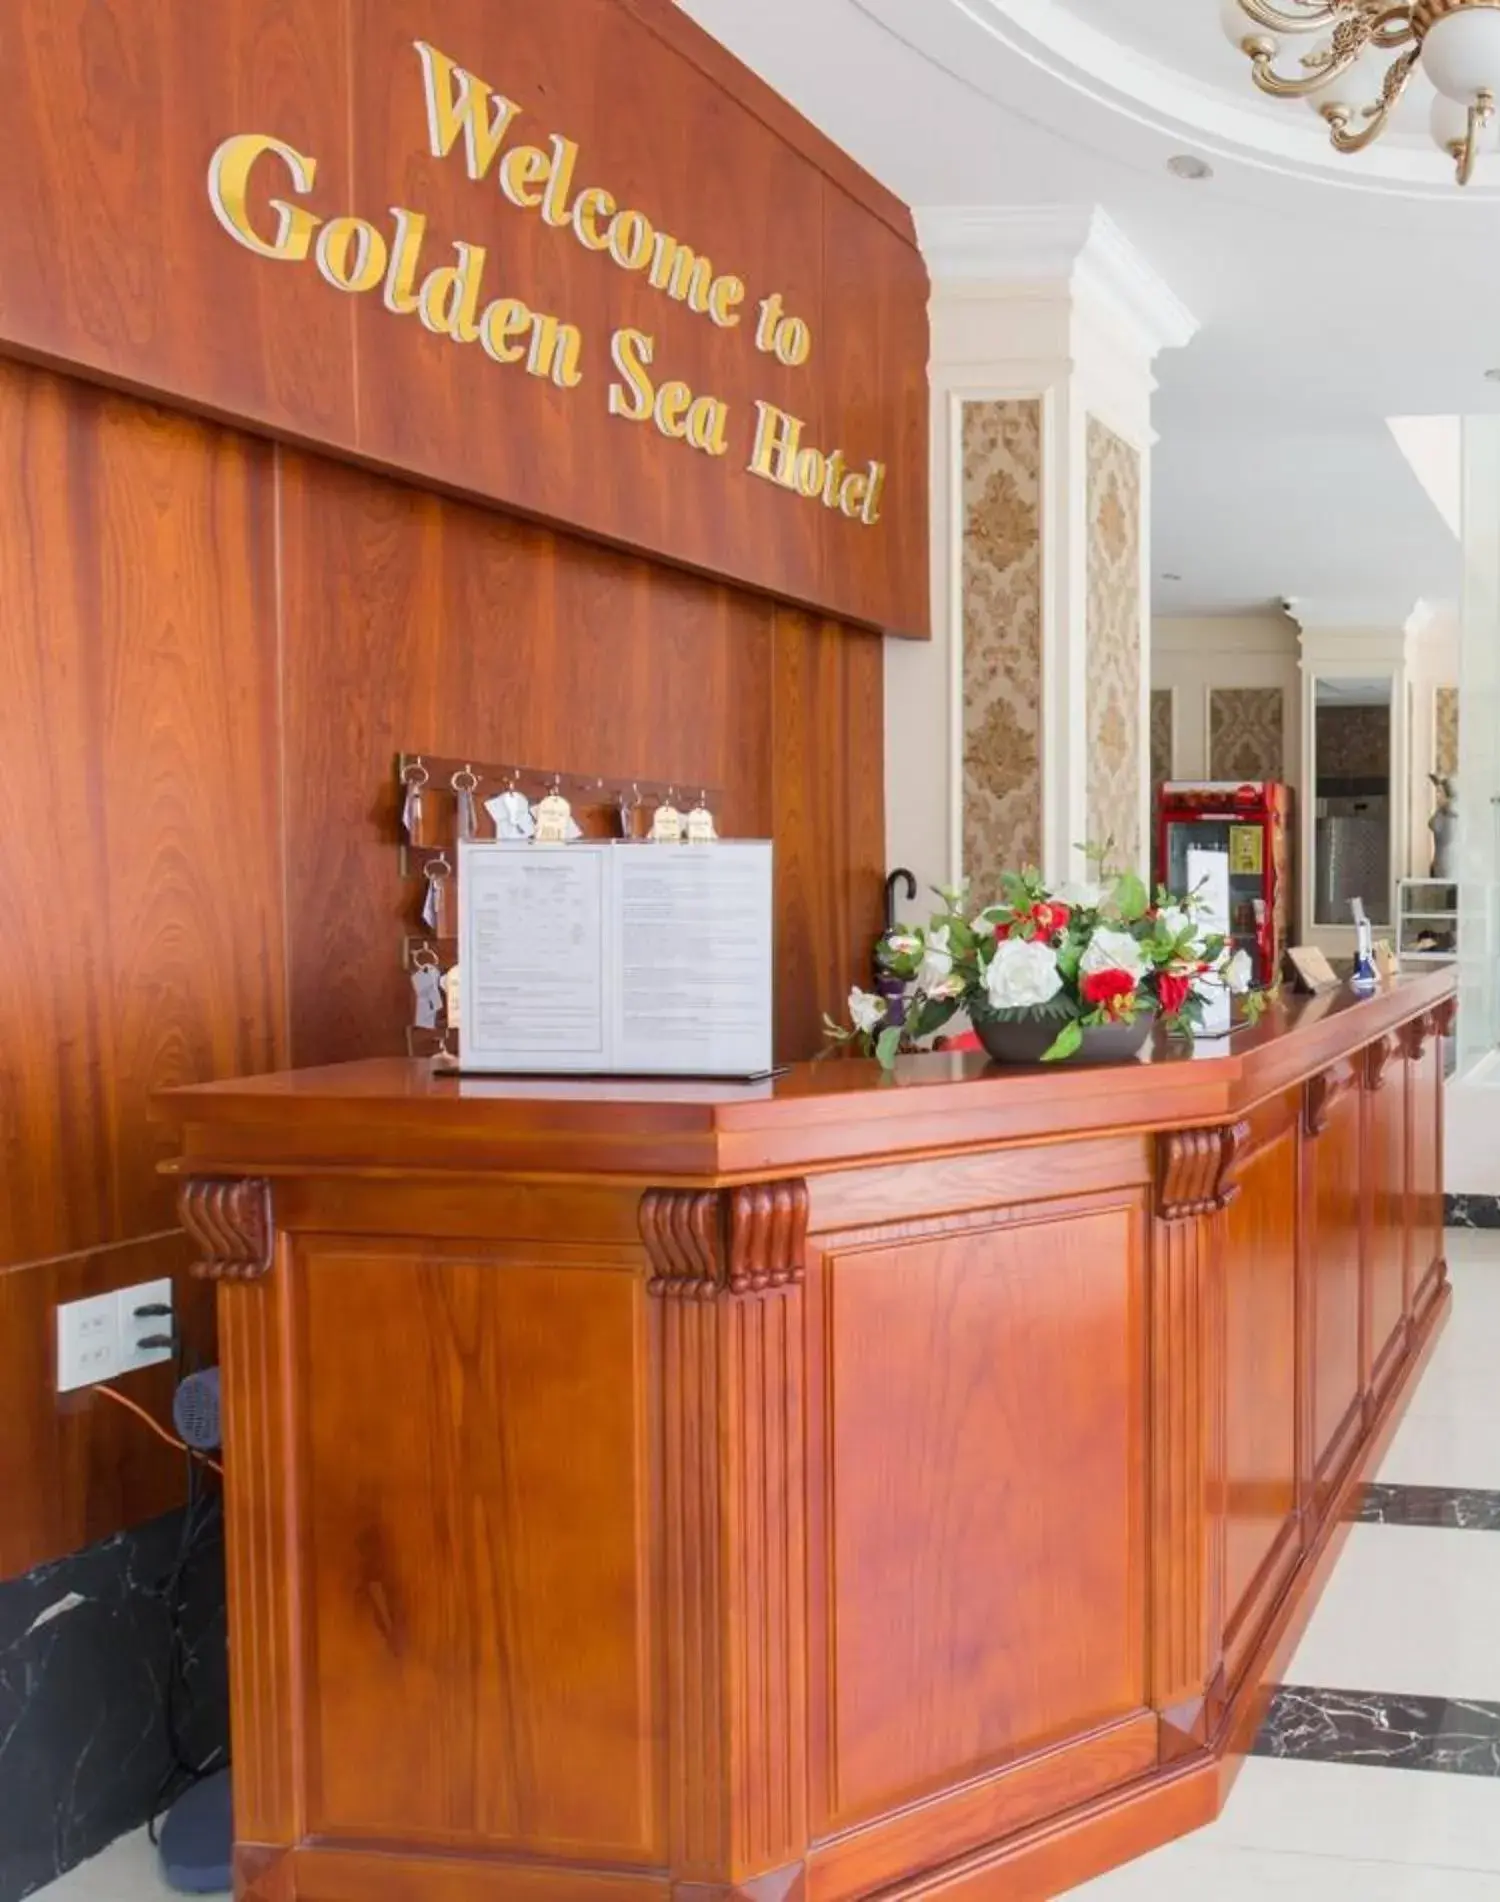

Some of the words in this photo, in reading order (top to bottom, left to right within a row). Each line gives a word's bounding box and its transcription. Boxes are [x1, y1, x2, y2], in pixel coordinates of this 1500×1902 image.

[207, 133, 582, 387] Golden
[609, 328, 727, 455] Sea
[746, 400, 885, 524] Hotel
[414, 41, 744, 327] Welcome
[755, 293, 810, 366] to
